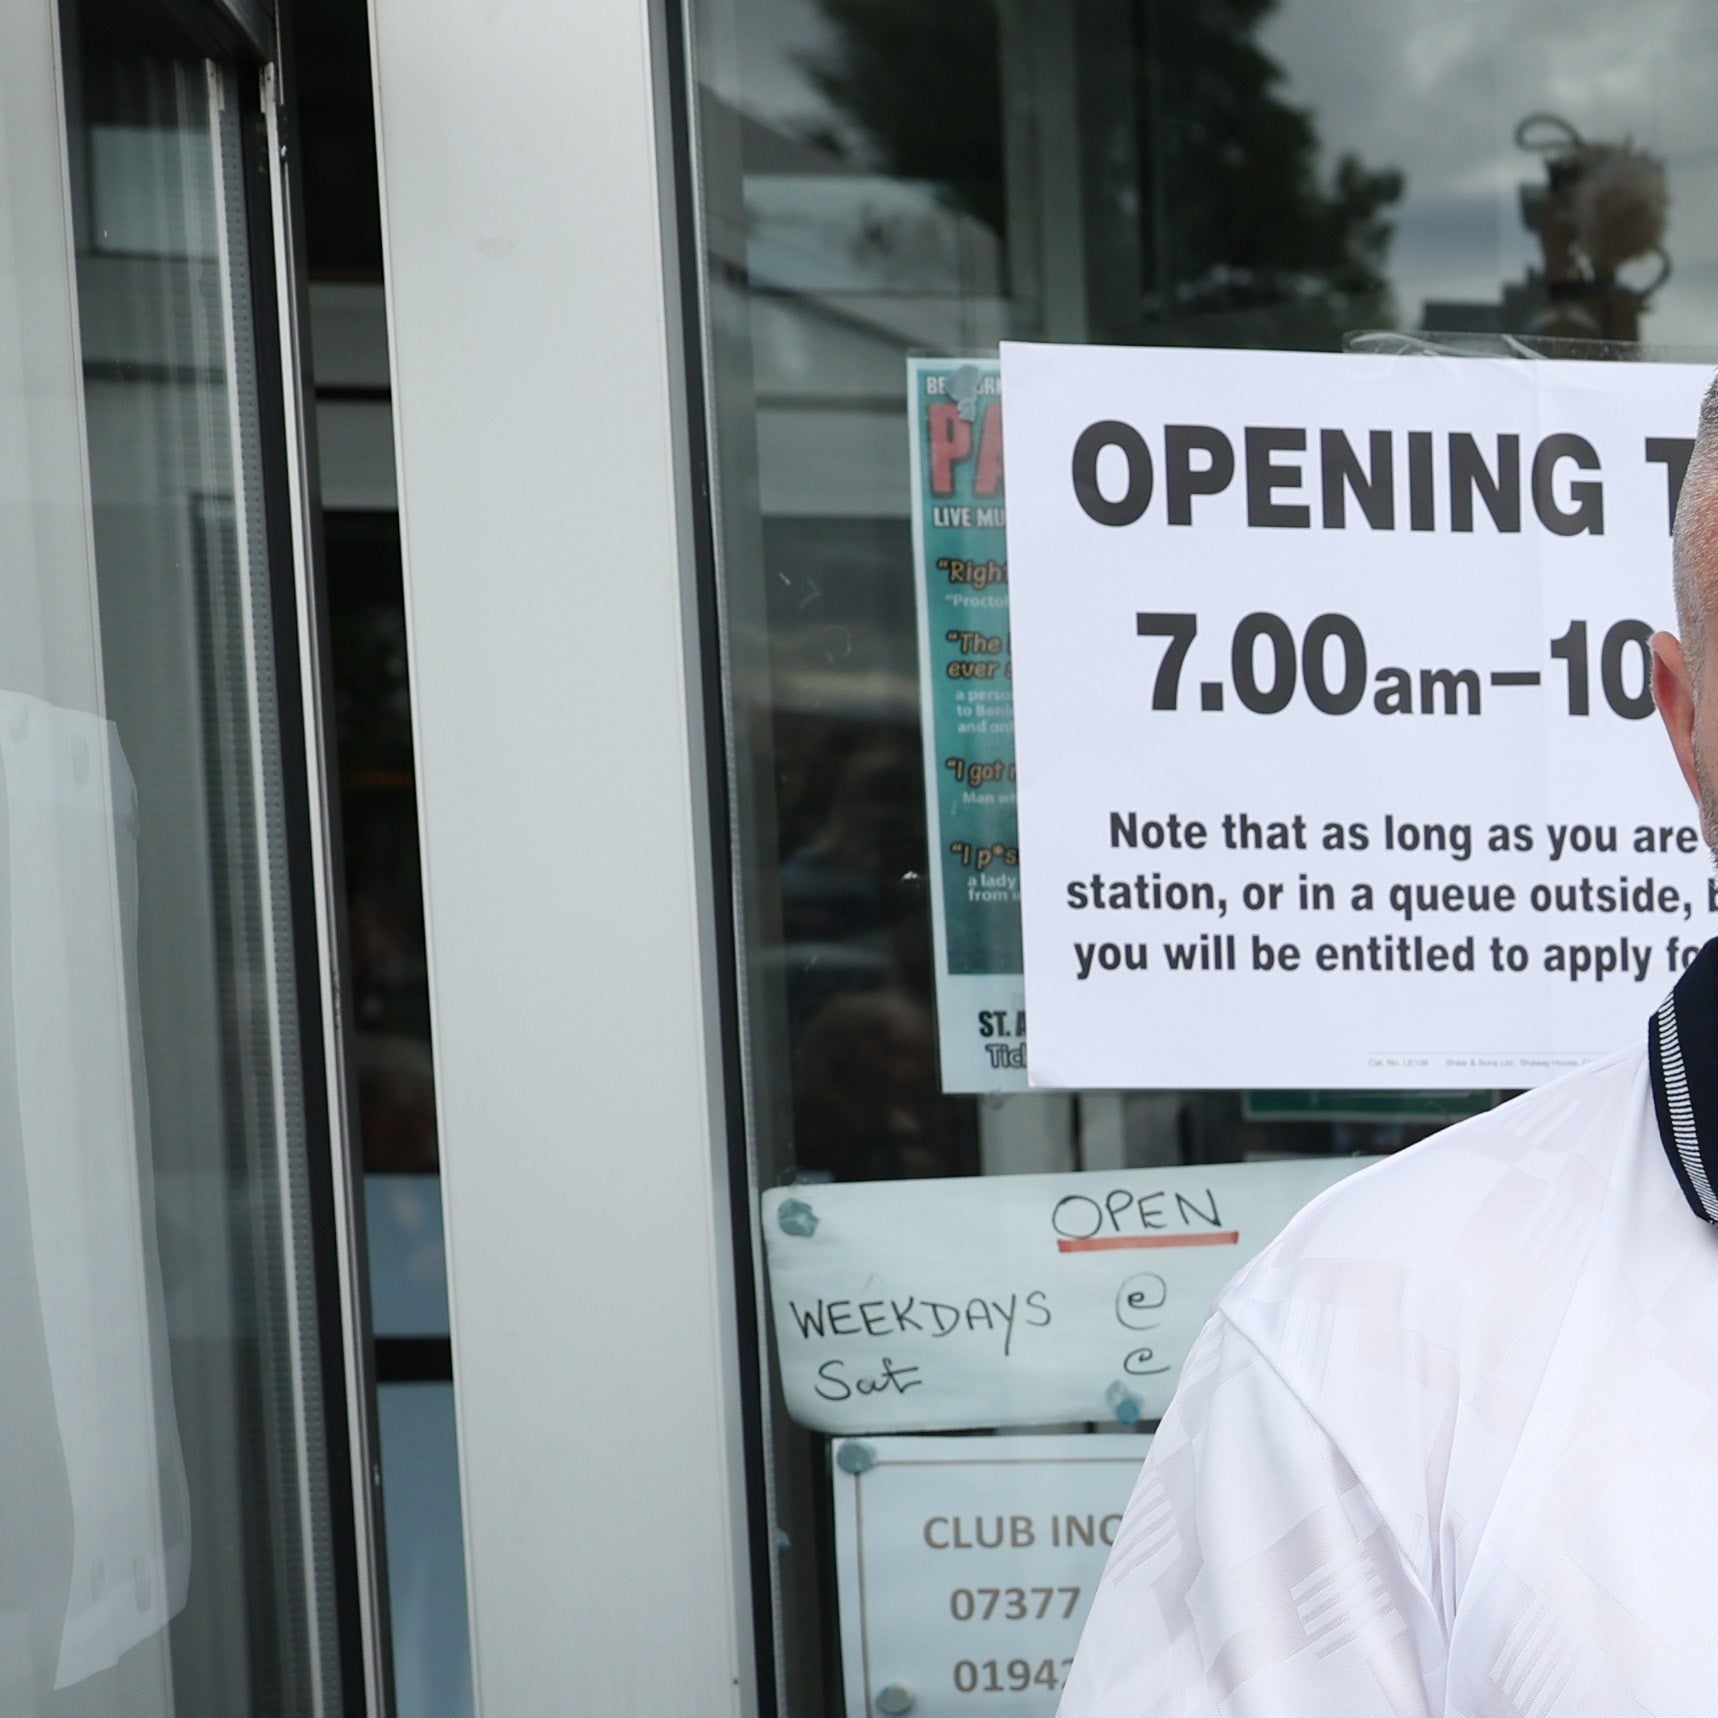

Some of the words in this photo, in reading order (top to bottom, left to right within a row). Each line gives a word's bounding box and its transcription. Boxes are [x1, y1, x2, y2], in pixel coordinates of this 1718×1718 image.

[1072, 419, 1605, 536] OPENING
[933, 506, 972, 528] LIVE
[947, 660, 999, 679] ever
[968, 760, 1003, 787] got
[1109, 811, 1208, 850] Note
[1221, 813, 1307, 850] that
[1322, 822, 1370, 851] as
[1385, 814, 1472, 861] long
[1488, 823, 1534, 852] as
[1547, 824, 1618, 861] you
[1633, 825, 1698, 853] are
[968, 889, 1008, 901] from
[980, 872, 1016, 889] lady
[1066, 872, 1227, 918] station,
[1243, 882, 1284, 911] or
[1299, 873, 1335, 910] in
[1351, 883, 1374, 911] a
[1389, 882, 1516, 921] queue
[1530, 876, 1692, 921] outside,
[1073, 942, 1148, 980] you
[1163, 934, 1236, 970] will
[1252, 934, 1301, 971] be
[1315, 934, 1475, 972] entitled
[1490, 937, 1529, 972] to
[1544, 936, 1653, 982] apply
[978, 1010, 1011, 1037] ST.
[1052, 1189, 1222, 1239] OPEN
[790, 1290, 1051, 1357] WEEKDAYS
[1115, 1272, 1167, 1330] @
[814, 1357, 924, 1402] Sat
[923, 1515, 1036, 1550] CLUB
[950, 1586, 1081, 1621] 07377
